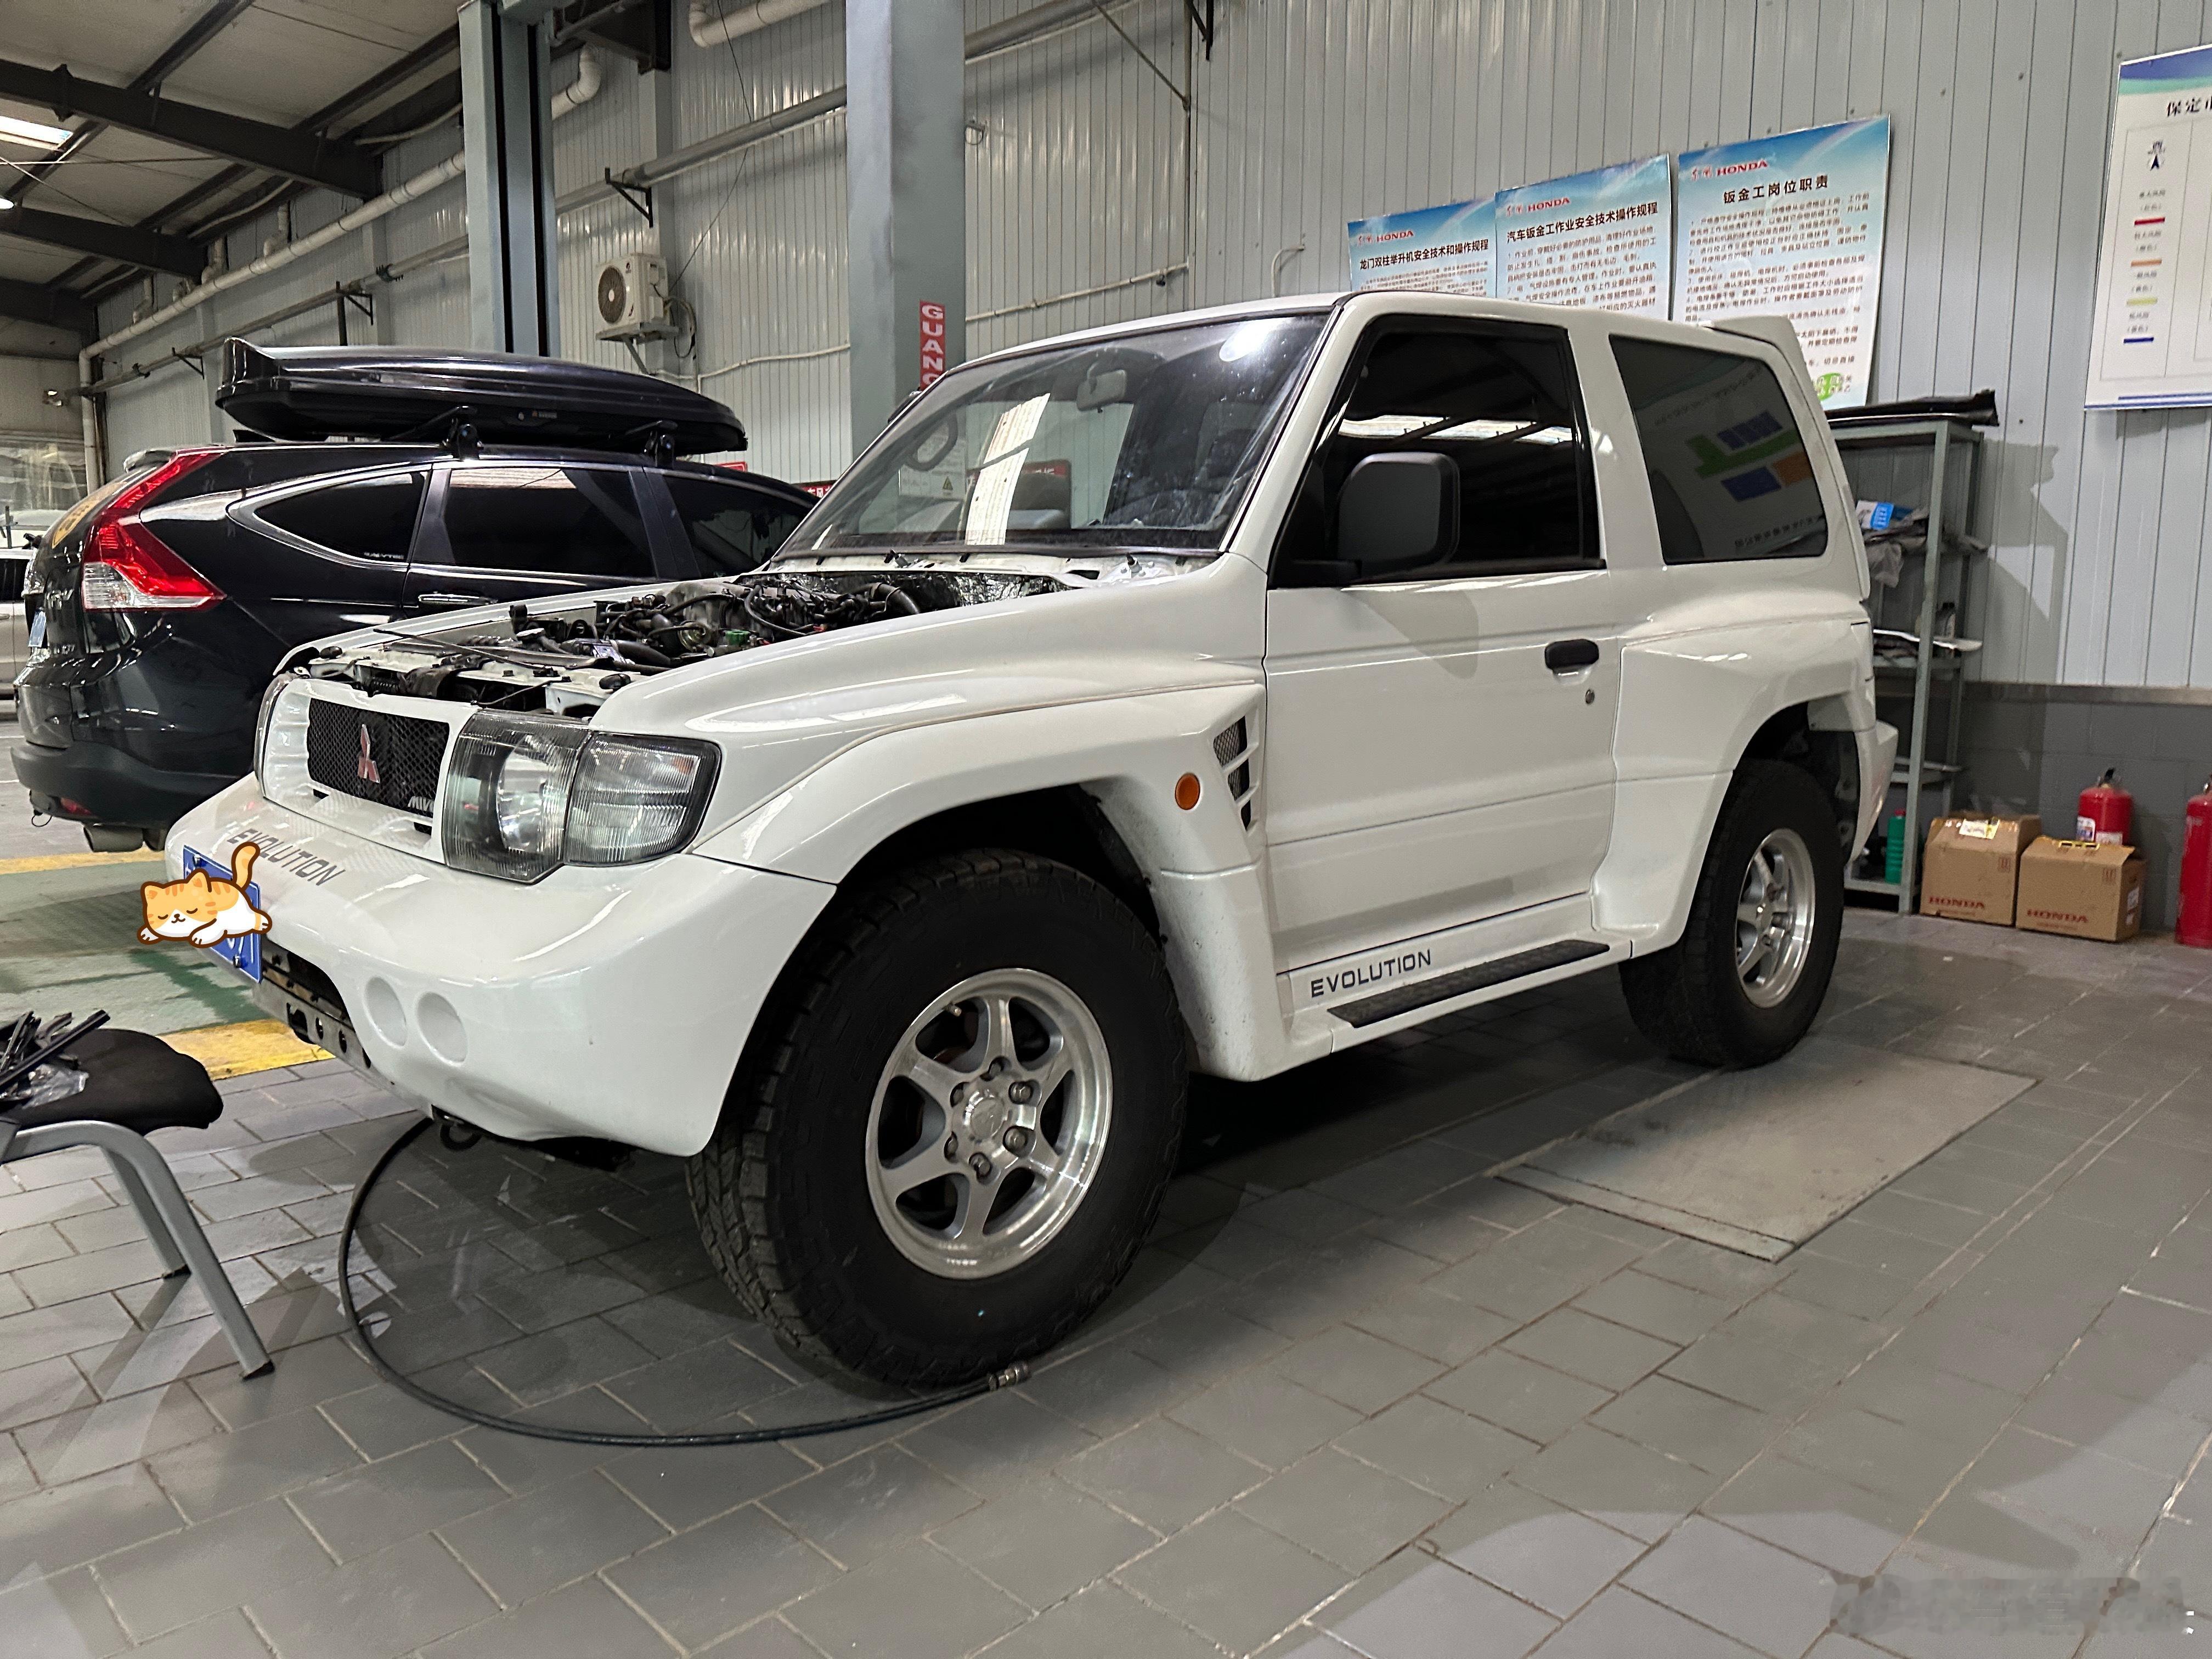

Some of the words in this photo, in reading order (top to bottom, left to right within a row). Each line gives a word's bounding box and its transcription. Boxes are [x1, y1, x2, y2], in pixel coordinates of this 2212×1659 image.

[1716, 159, 1768, 176] HONDA
[1724, 174, 1829, 204] 钣金工岗位职责
[1527, 198, 1570, 212] HONDA
[1507, 201, 1658, 243] 汽车钣金工作业安全技术操作规程
[1376, 230, 1414, 242] HONDA
[1359, 239, 1488, 270] 龙门双柱举升机安全技术和操作规程
[227, 828, 346, 886] EVOLUTION
[1929, 896, 1985, 910] HONDA
[2027, 909, 2088, 923] HONDA
[1311, 949, 1431, 997] EVOLUTION
